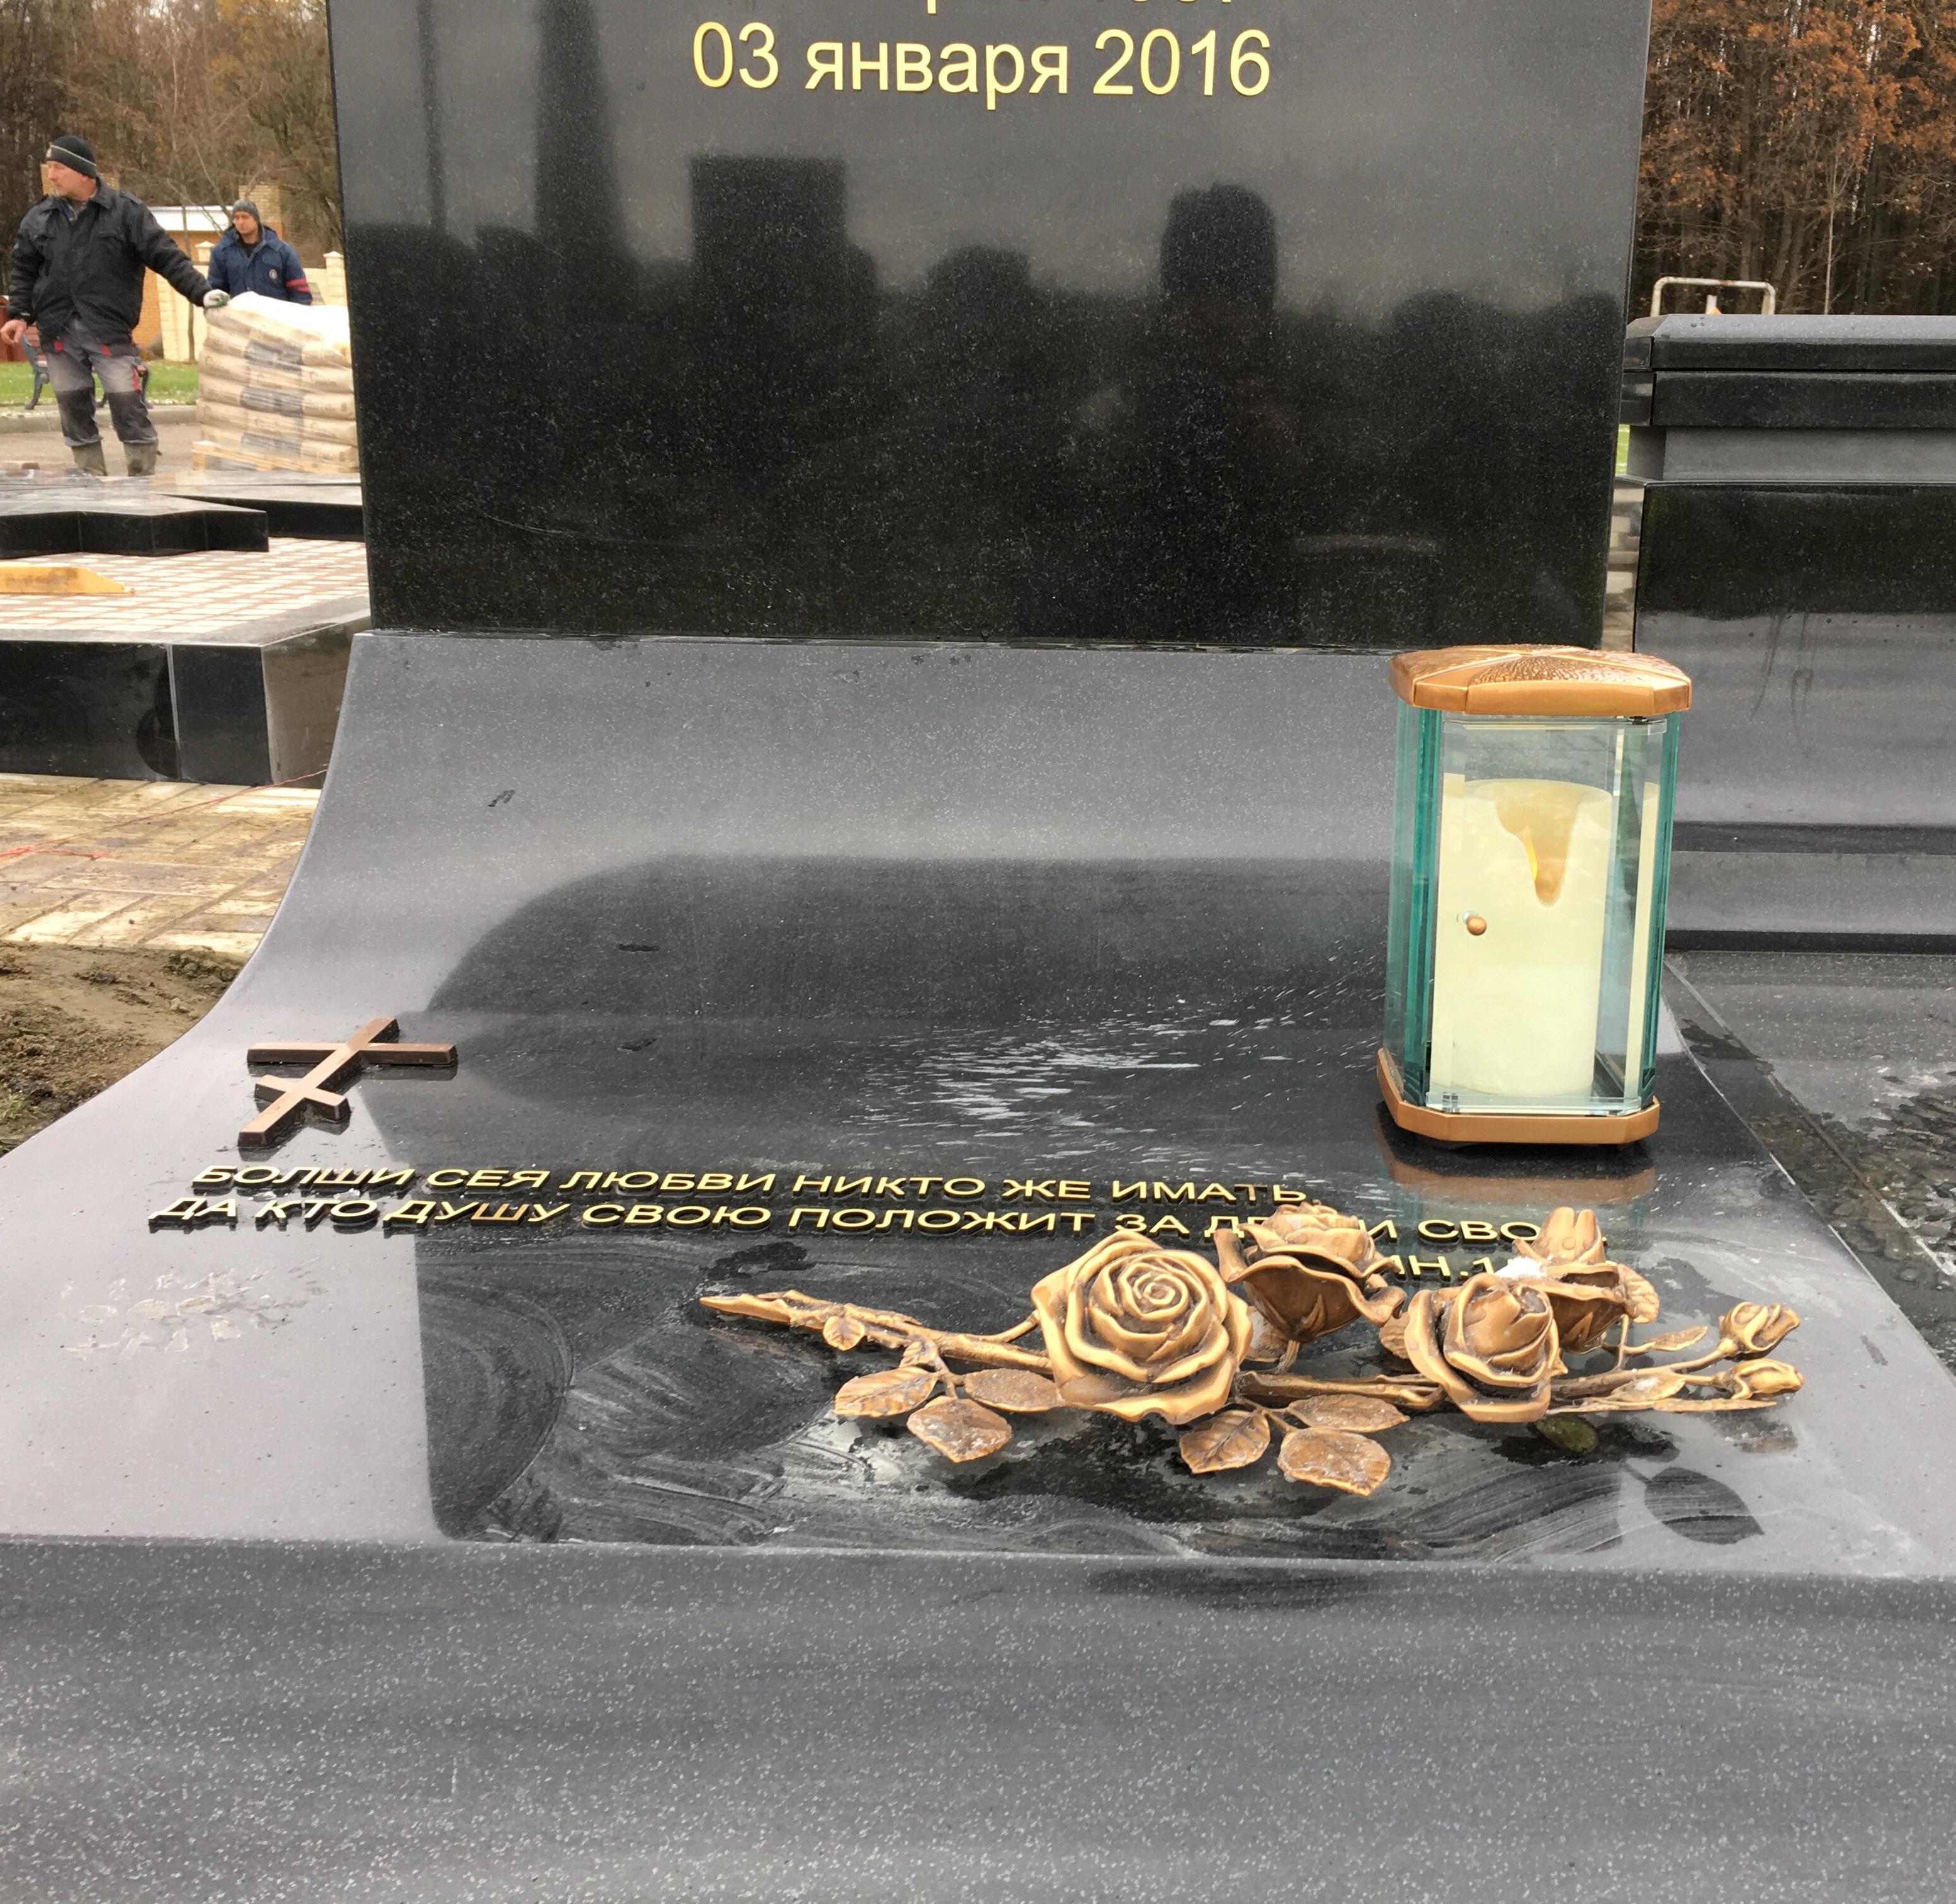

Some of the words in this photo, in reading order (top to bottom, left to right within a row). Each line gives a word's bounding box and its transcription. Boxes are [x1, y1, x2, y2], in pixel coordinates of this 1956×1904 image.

[692, 21, 779, 89] 03
[805, 40, 1069, 110] января
[1092, 28, 1272, 96] 2016
[191, 1165, 415, 1187] БОЛШИ
[426, 1168, 550, 1189] СЕЯ
[559, 1171, 776, 1192] ЛЮБВИ
[792, 1175, 985, 1196] НИКТО
[1002, 1179, 1092, 1200] ЖЕ
[147, 1197, 237, 1221] ДА
[254, 1199, 379, 1220] КТО
[383, 1199, 569, 1224] ДУШУ
[581, 1204, 771, 1225] СВОЮ
[788, 1208, 1096, 1232] ПОЛОЖИТ
[1114, 1213, 1190, 1235] ЗА
